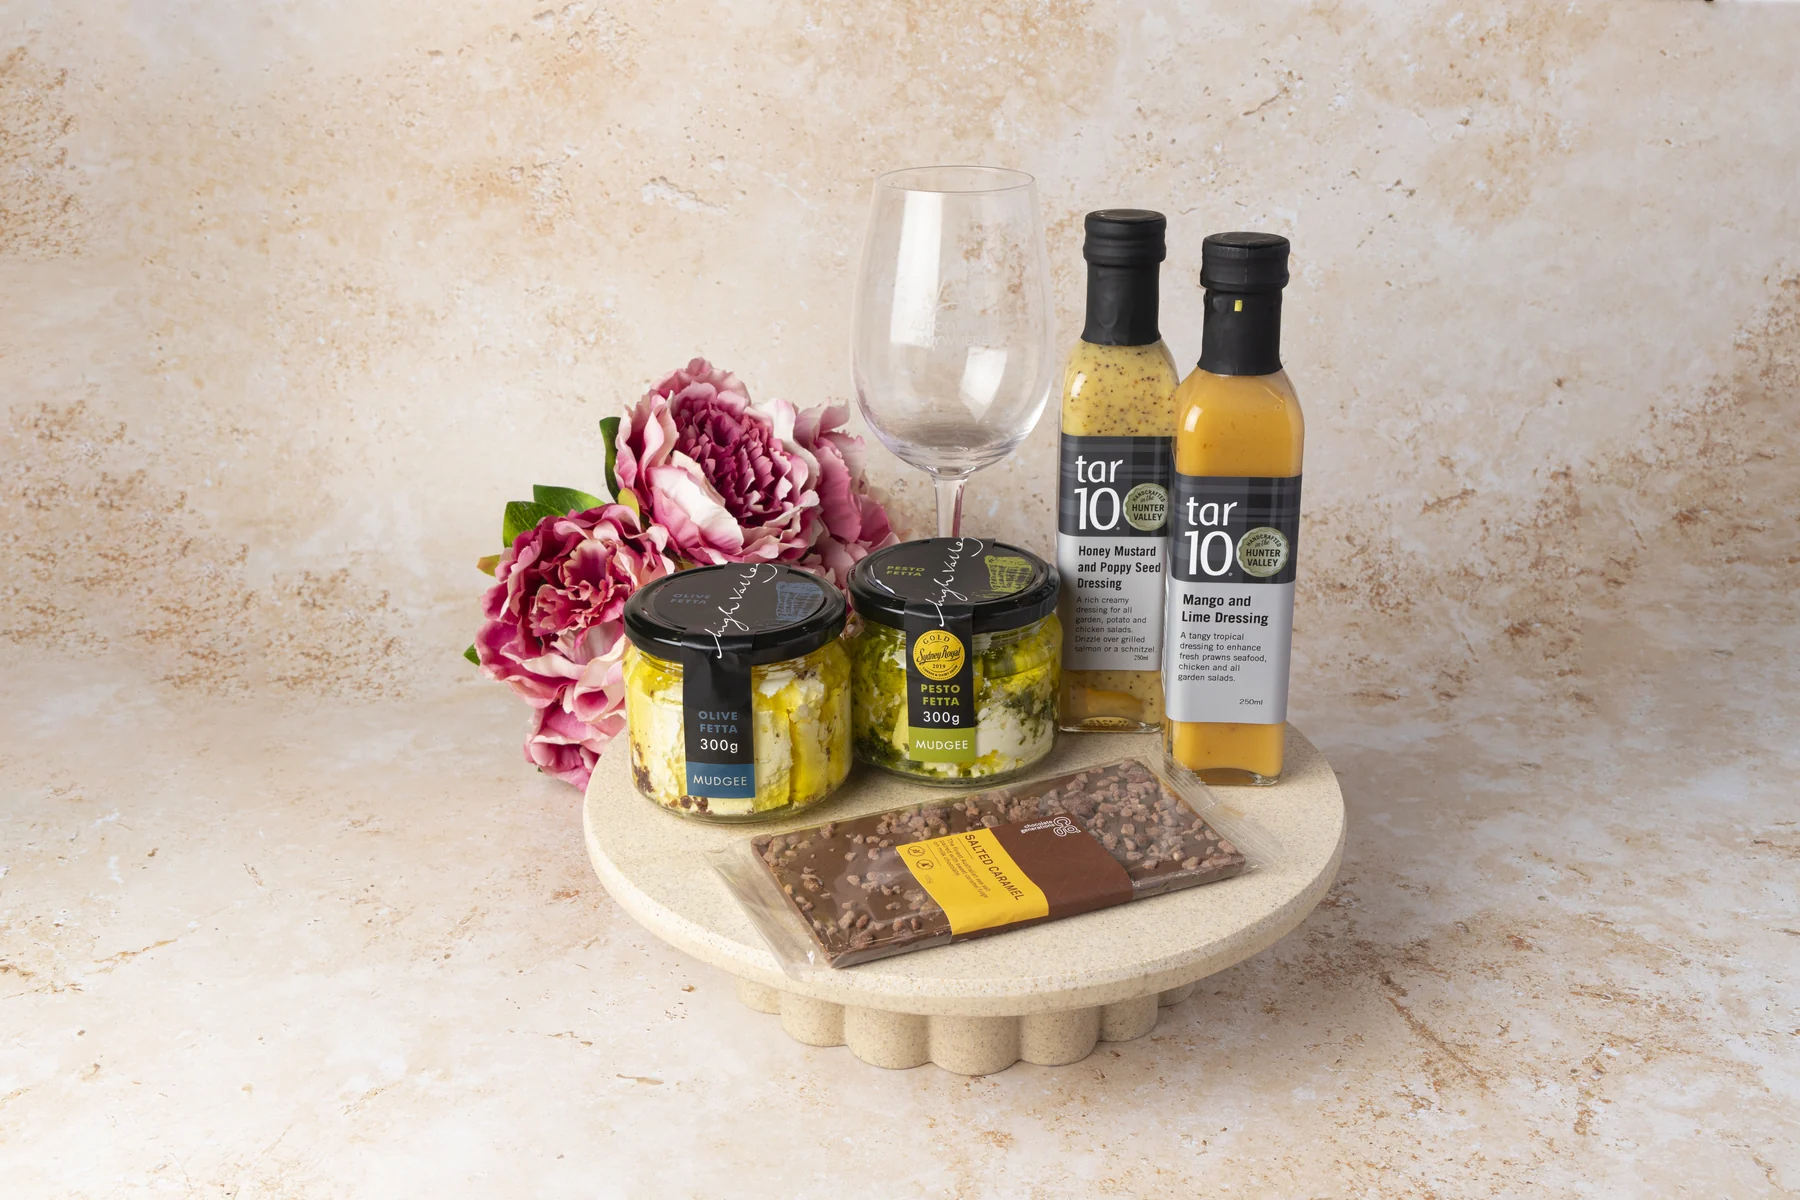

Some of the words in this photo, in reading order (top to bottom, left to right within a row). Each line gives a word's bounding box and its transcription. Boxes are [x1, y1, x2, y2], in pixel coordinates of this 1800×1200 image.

[1075, 456, 1123, 483] tar
[1132, 490, 1165, 502] HANDCRAFTED
[1074, 488, 1120, 530] 10
[1186, 497, 1238, 526] tar
[1246, 534, 1282, 547] HANDCRAFTED
[1079, 546, 1110, 558] Honey
[1114, 546, 1156, 556] Mustard
[1184, 531, 1233, 576] 10
[1078, 562, 1096, 572] and
[1100, 562, 1131, 574] Poppy
[1136, 562, 1160, 572] Seed
[1078, 578, 1122, 590] Dressing
[1183, 594, 1224, 608] Mango
[1229, 596, 1251, 606] and
[1182, 611, 1210, 622] Lime
[1215, 612, 1268, 626] Dressing
[923, 635, 950, 644] GOLD
[1189, 632, 1211, 640] tangy
[1214, 633, 1244, 641] tropical
[1180, 643, 1213, 651] dressing
[917, 648, 941, 665] Sydney
[941, 645, 961, 659] Royal
[1233, 654, 1267, 662] seafood,
[921, 684, 960, 694] PESTO
[923, 697, 959, 706] FETTA
[698, 711, 738, 720] OLIVE
[923, 711, 959, 725] 300g
[700, 724, 738, 733] FETTA
[700, 738, 738, 753] 300g
[916, 740, 968, 750] MUDGEE
[693, 775, 747, 786] MUDGEE
[965, 834, 993, 865] SALTED
[989, 866, 1024, 900] CARAMEL
